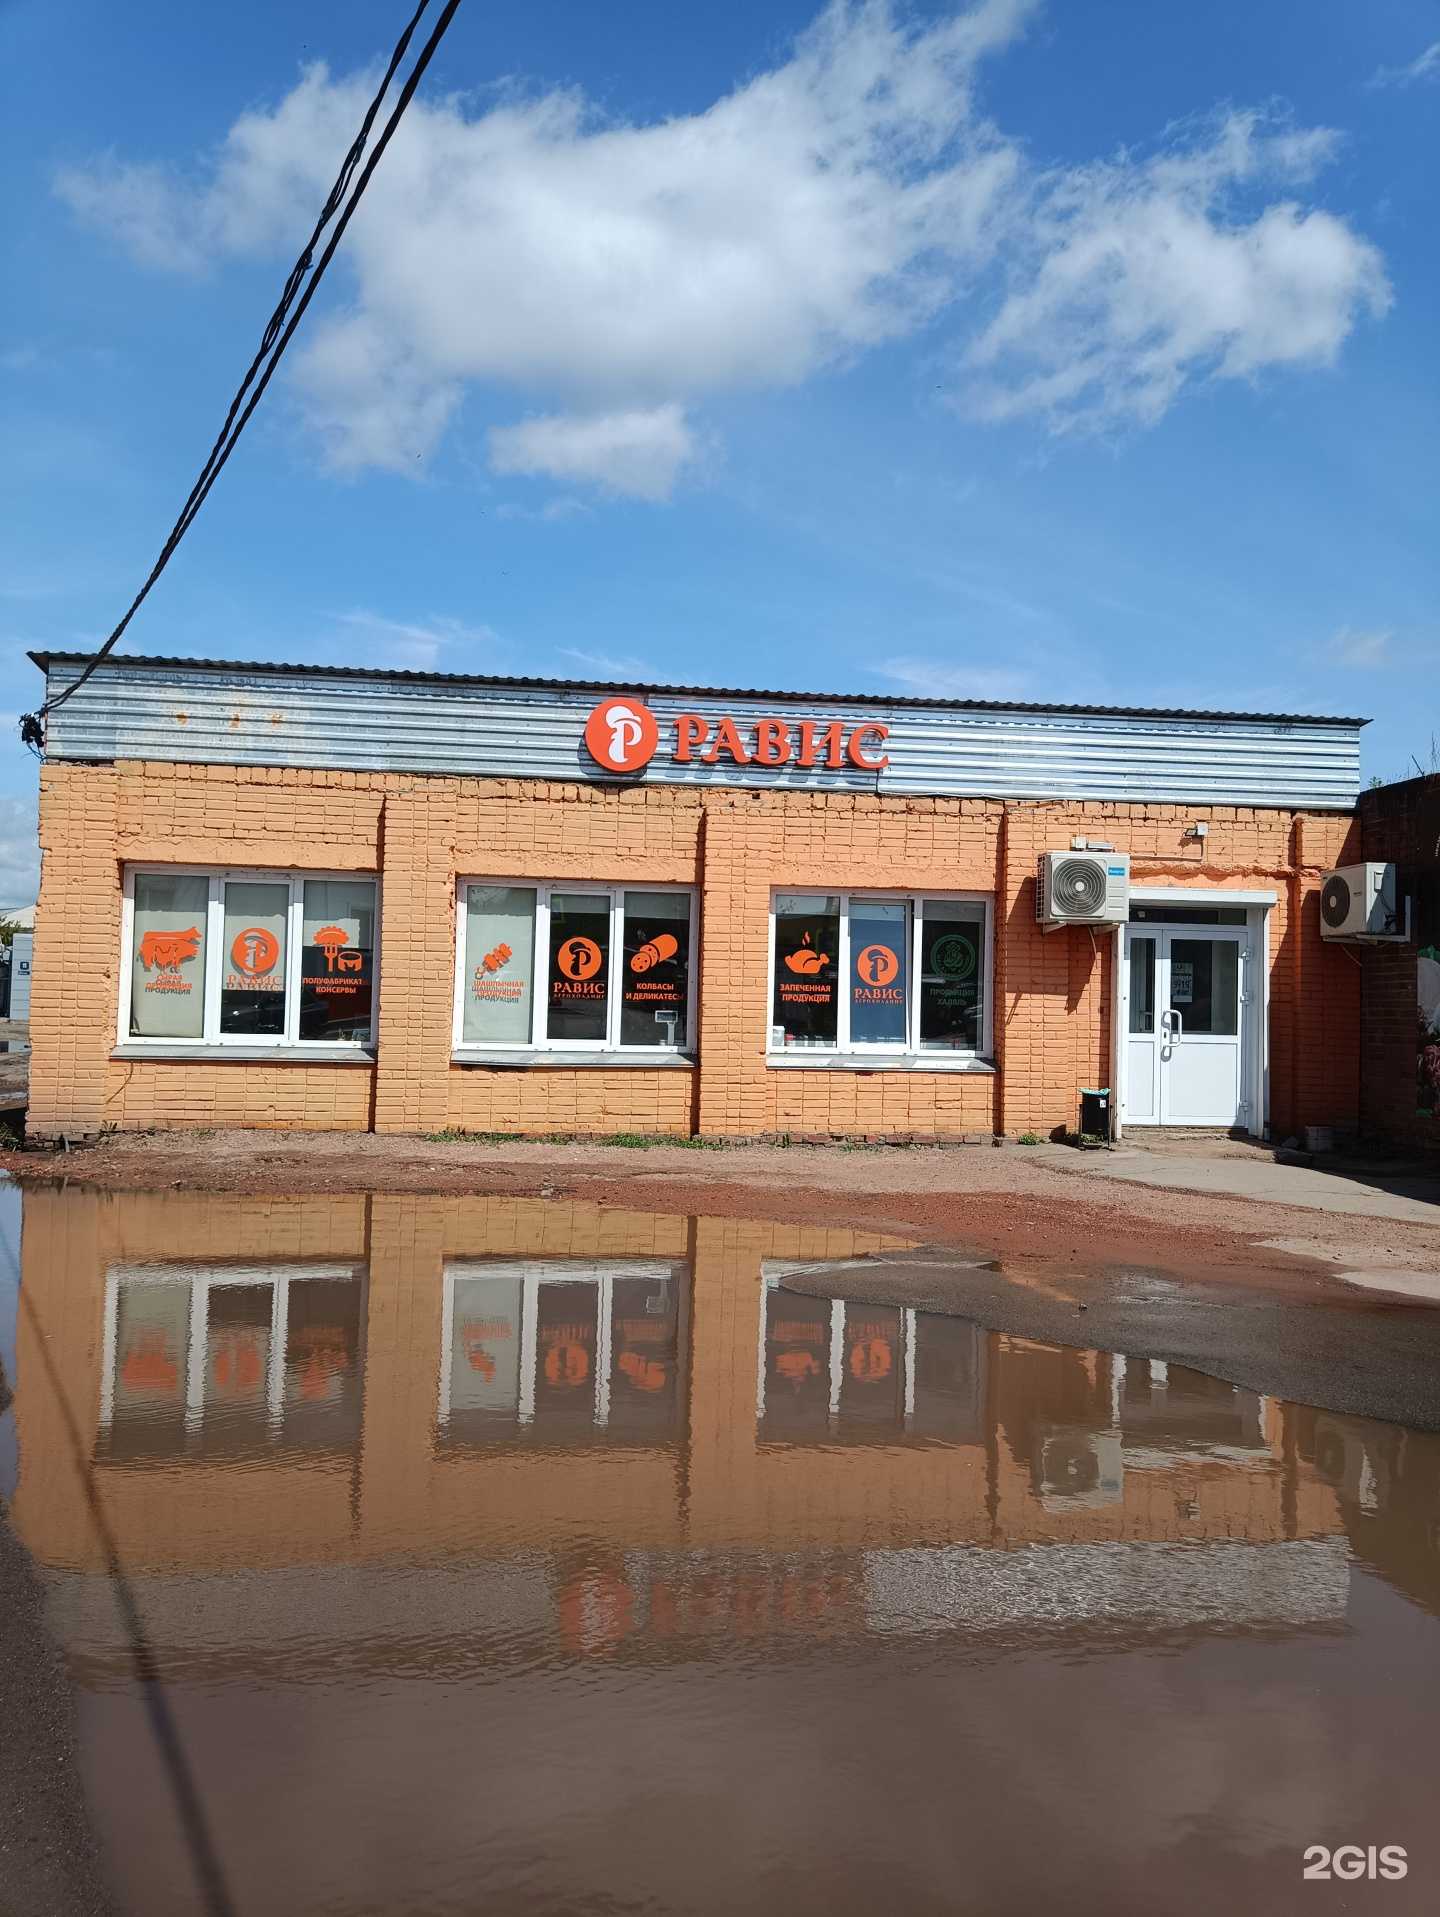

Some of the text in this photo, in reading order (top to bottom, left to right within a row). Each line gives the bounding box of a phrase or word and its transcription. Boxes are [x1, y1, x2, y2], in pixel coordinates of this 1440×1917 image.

[672, 714, 889, 769] РАВИС
[553, 982, 605, 994] РАВИС
[780, 983, 831, 992] ЗАПЕЧЕННАЯ
[782, 993, 831, 1003] ПРОДУКЦИЯ
[854, 988, 903, 999] РАВИС
